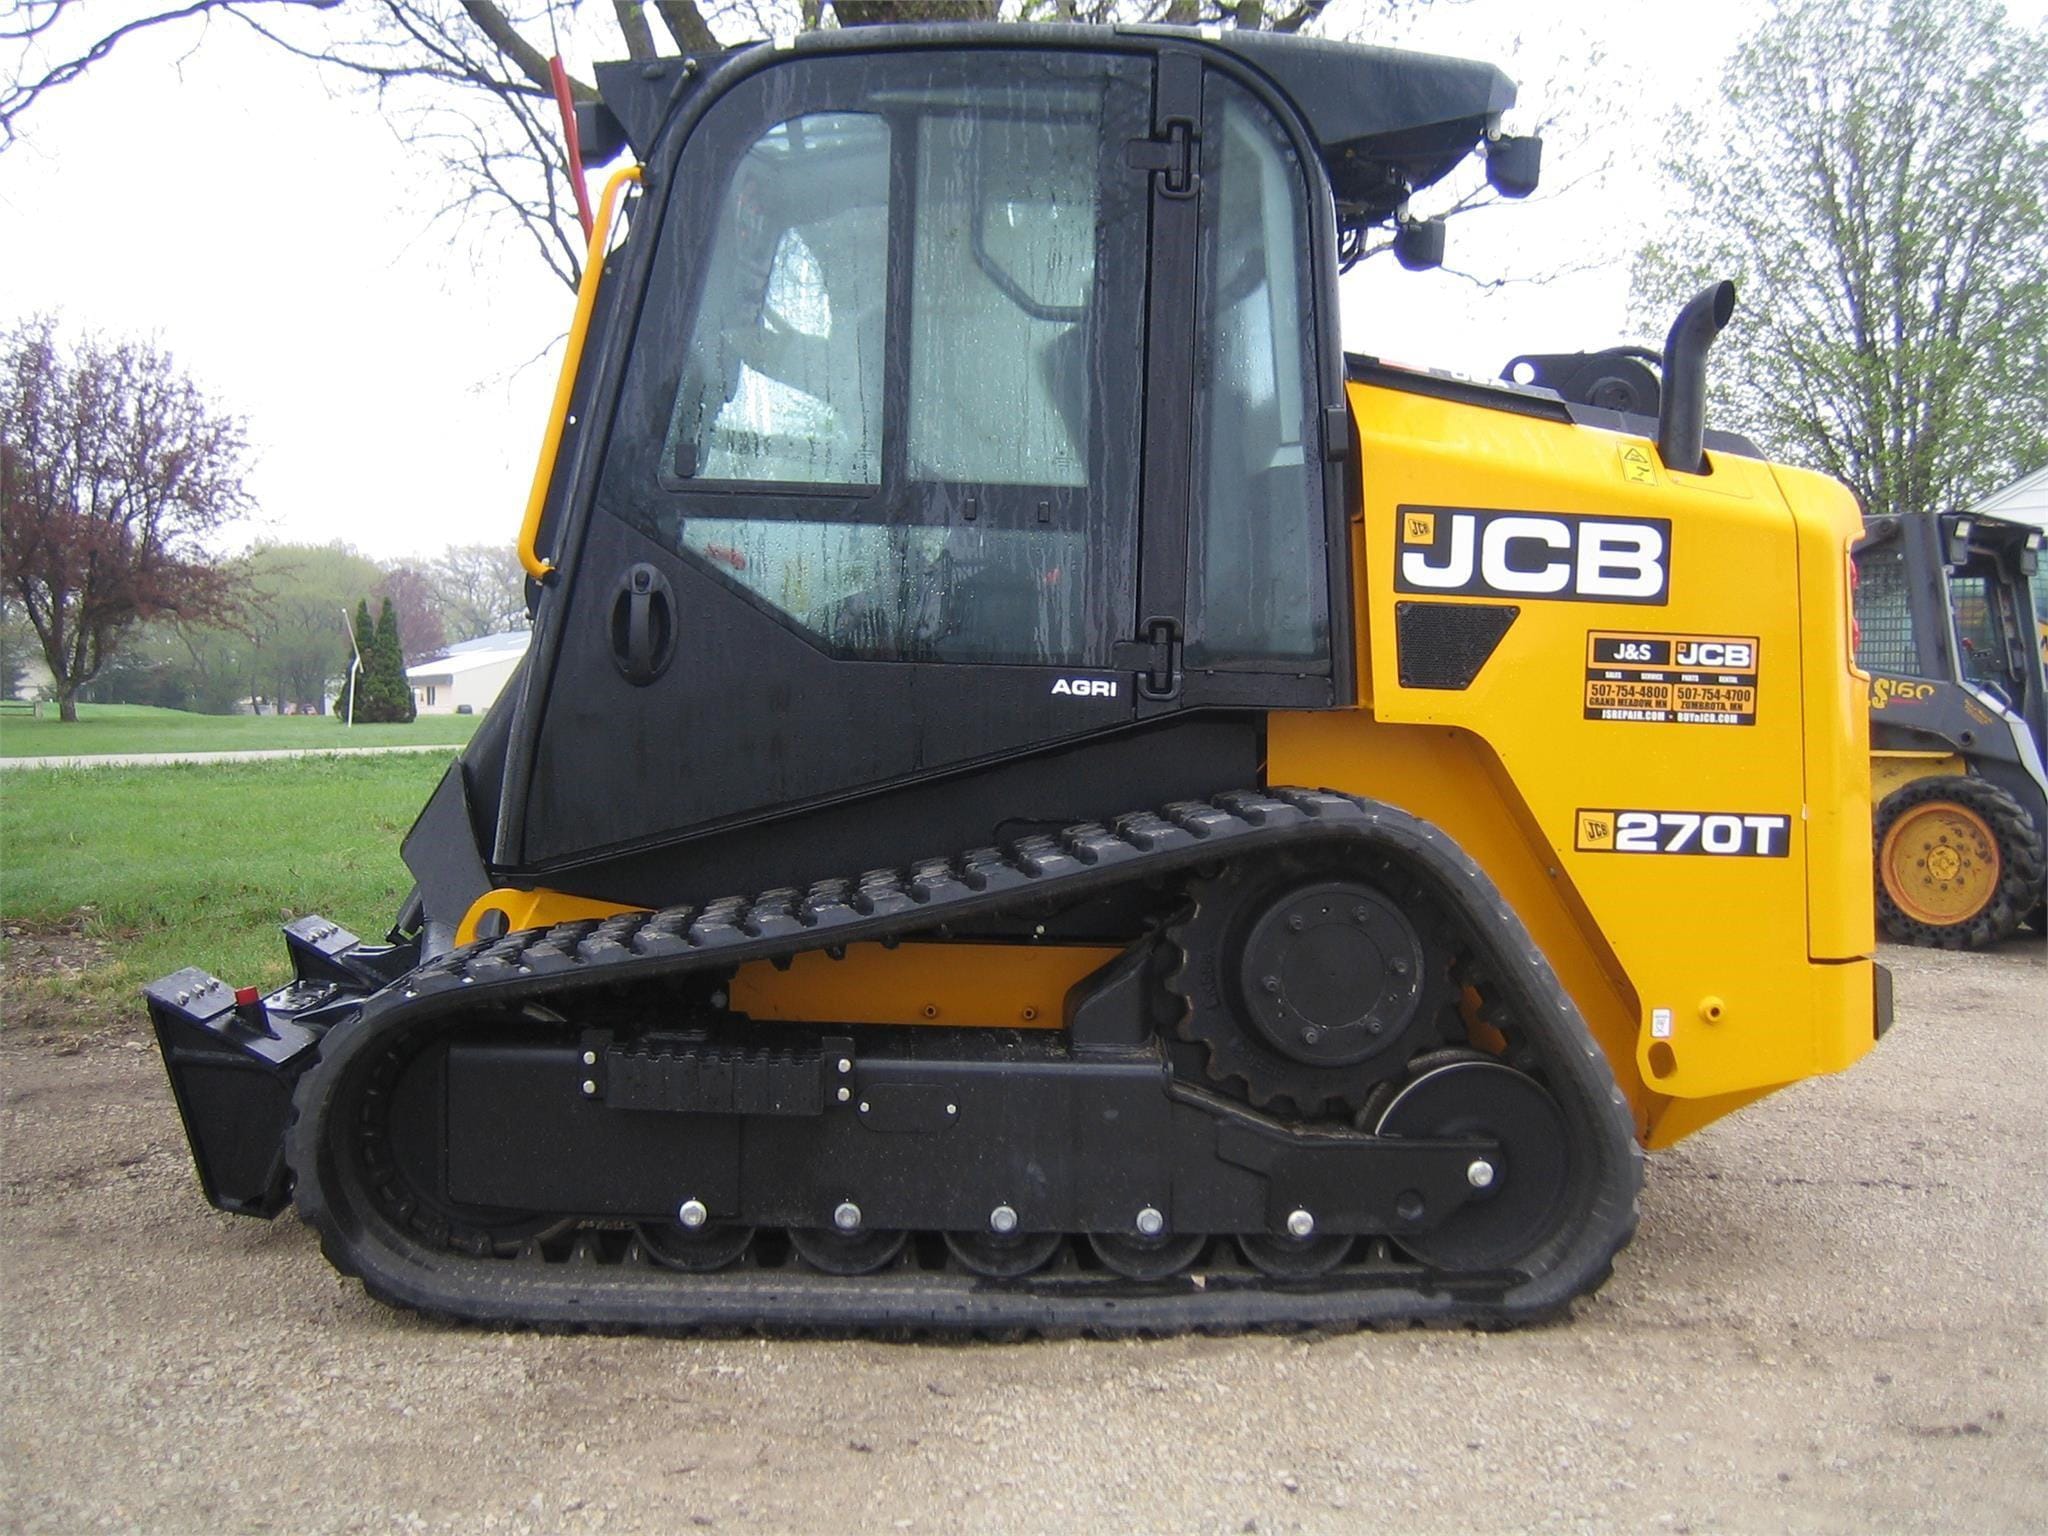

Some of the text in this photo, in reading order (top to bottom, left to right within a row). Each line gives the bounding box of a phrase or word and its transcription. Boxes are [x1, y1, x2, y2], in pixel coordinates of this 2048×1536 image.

[1402, 514, 1664, 598] JCB
[1613, 643, 1652, 661] J&S
[1677, 643, 1750, 667] JCB
[1051, 678, 1117, 697] AGRI
[1591, 683, 1668, 699] 507-754-4800
[1677, 686, 1751, 702] 507-754-4700
[1589, 697, 1616, 707] GRAND
[1655, 700, 1667, 709] MN
[1729, 702, 1743, 712] MN
[1602, 709, 1665, 722] JSREPAIR.COM
[1615, 812, 1784, 855] 270T
